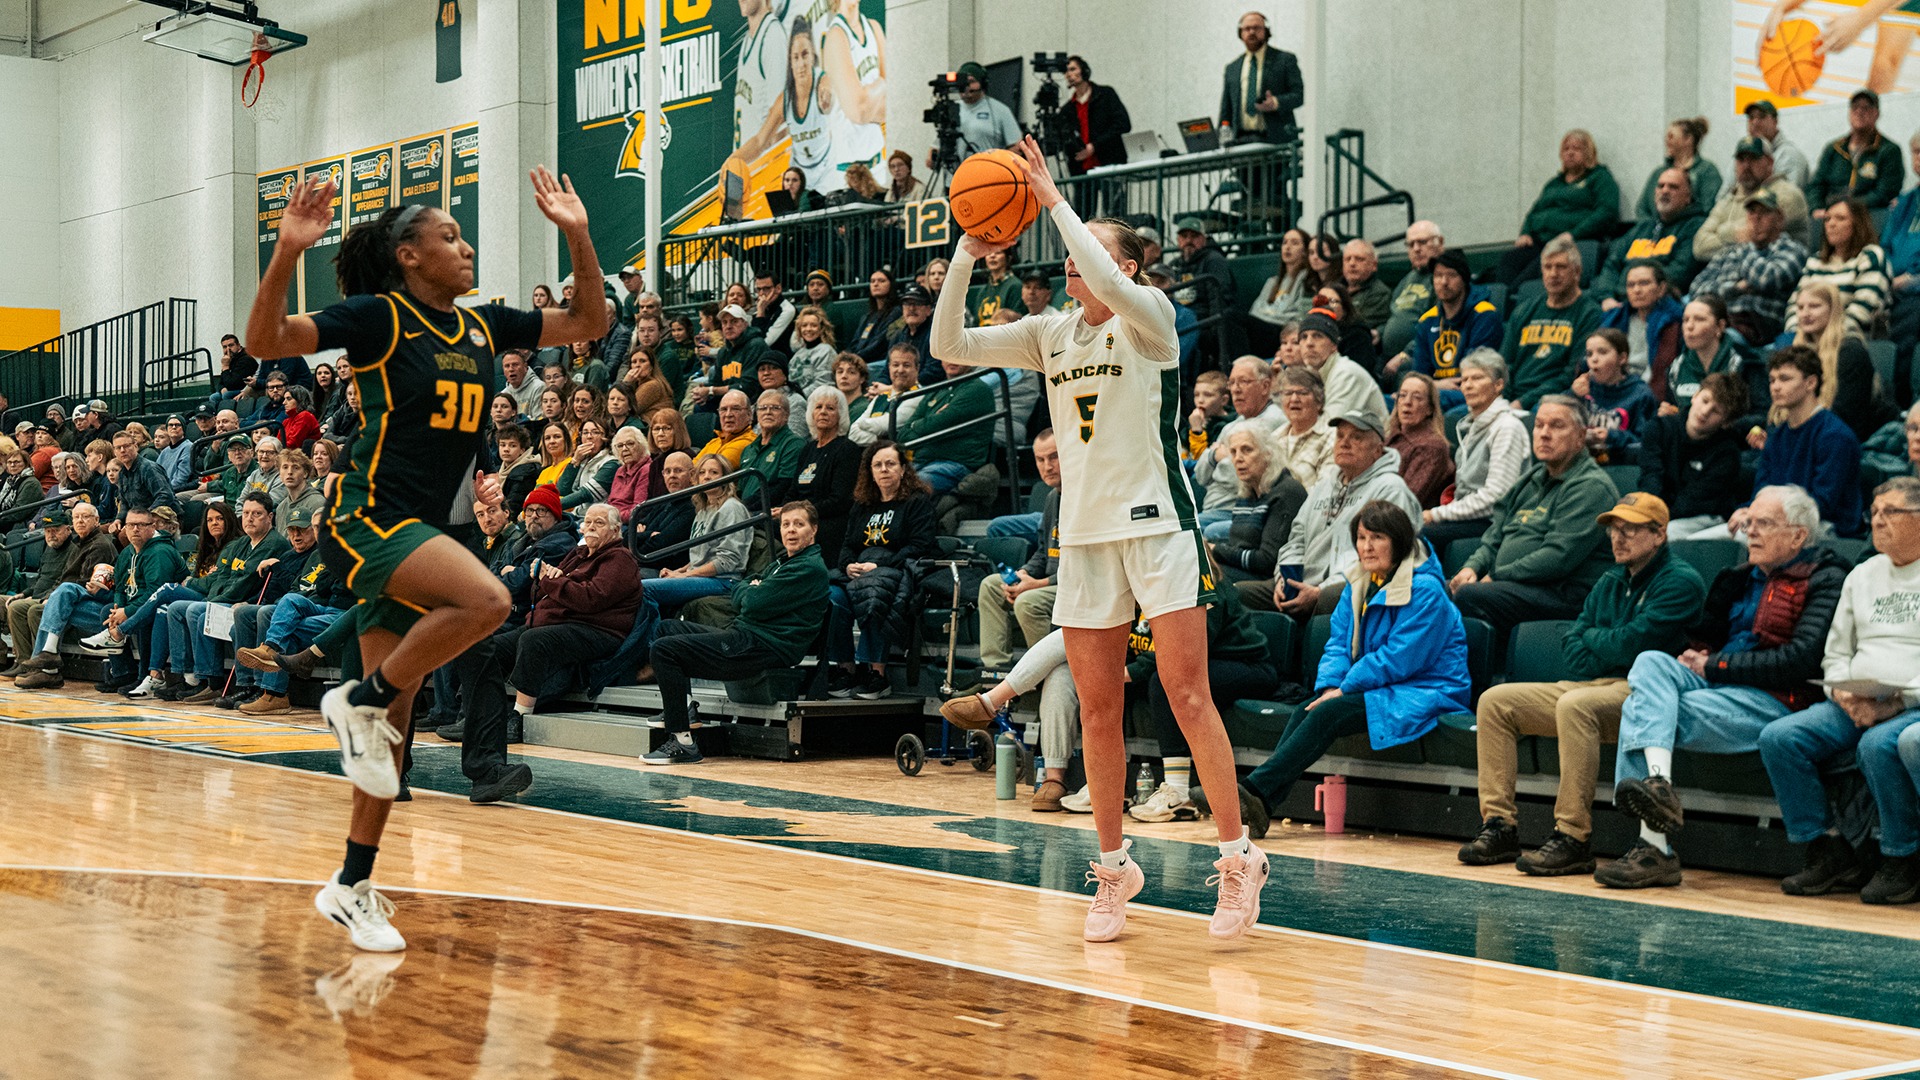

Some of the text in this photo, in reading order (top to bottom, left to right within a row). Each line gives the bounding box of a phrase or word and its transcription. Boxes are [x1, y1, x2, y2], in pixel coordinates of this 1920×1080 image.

[575, 32, 722, 123] WOMEN'S BSKETBALL
[906, 201, 947, 246] 12
[433, 352, 478, 374] WSU
[1049, 363, 1123, 388] WLDCATS
[429, 379, 485, 433] 30
[1073, 392, 1100, 446] 5
[1201, 573, 1215, 592] N
